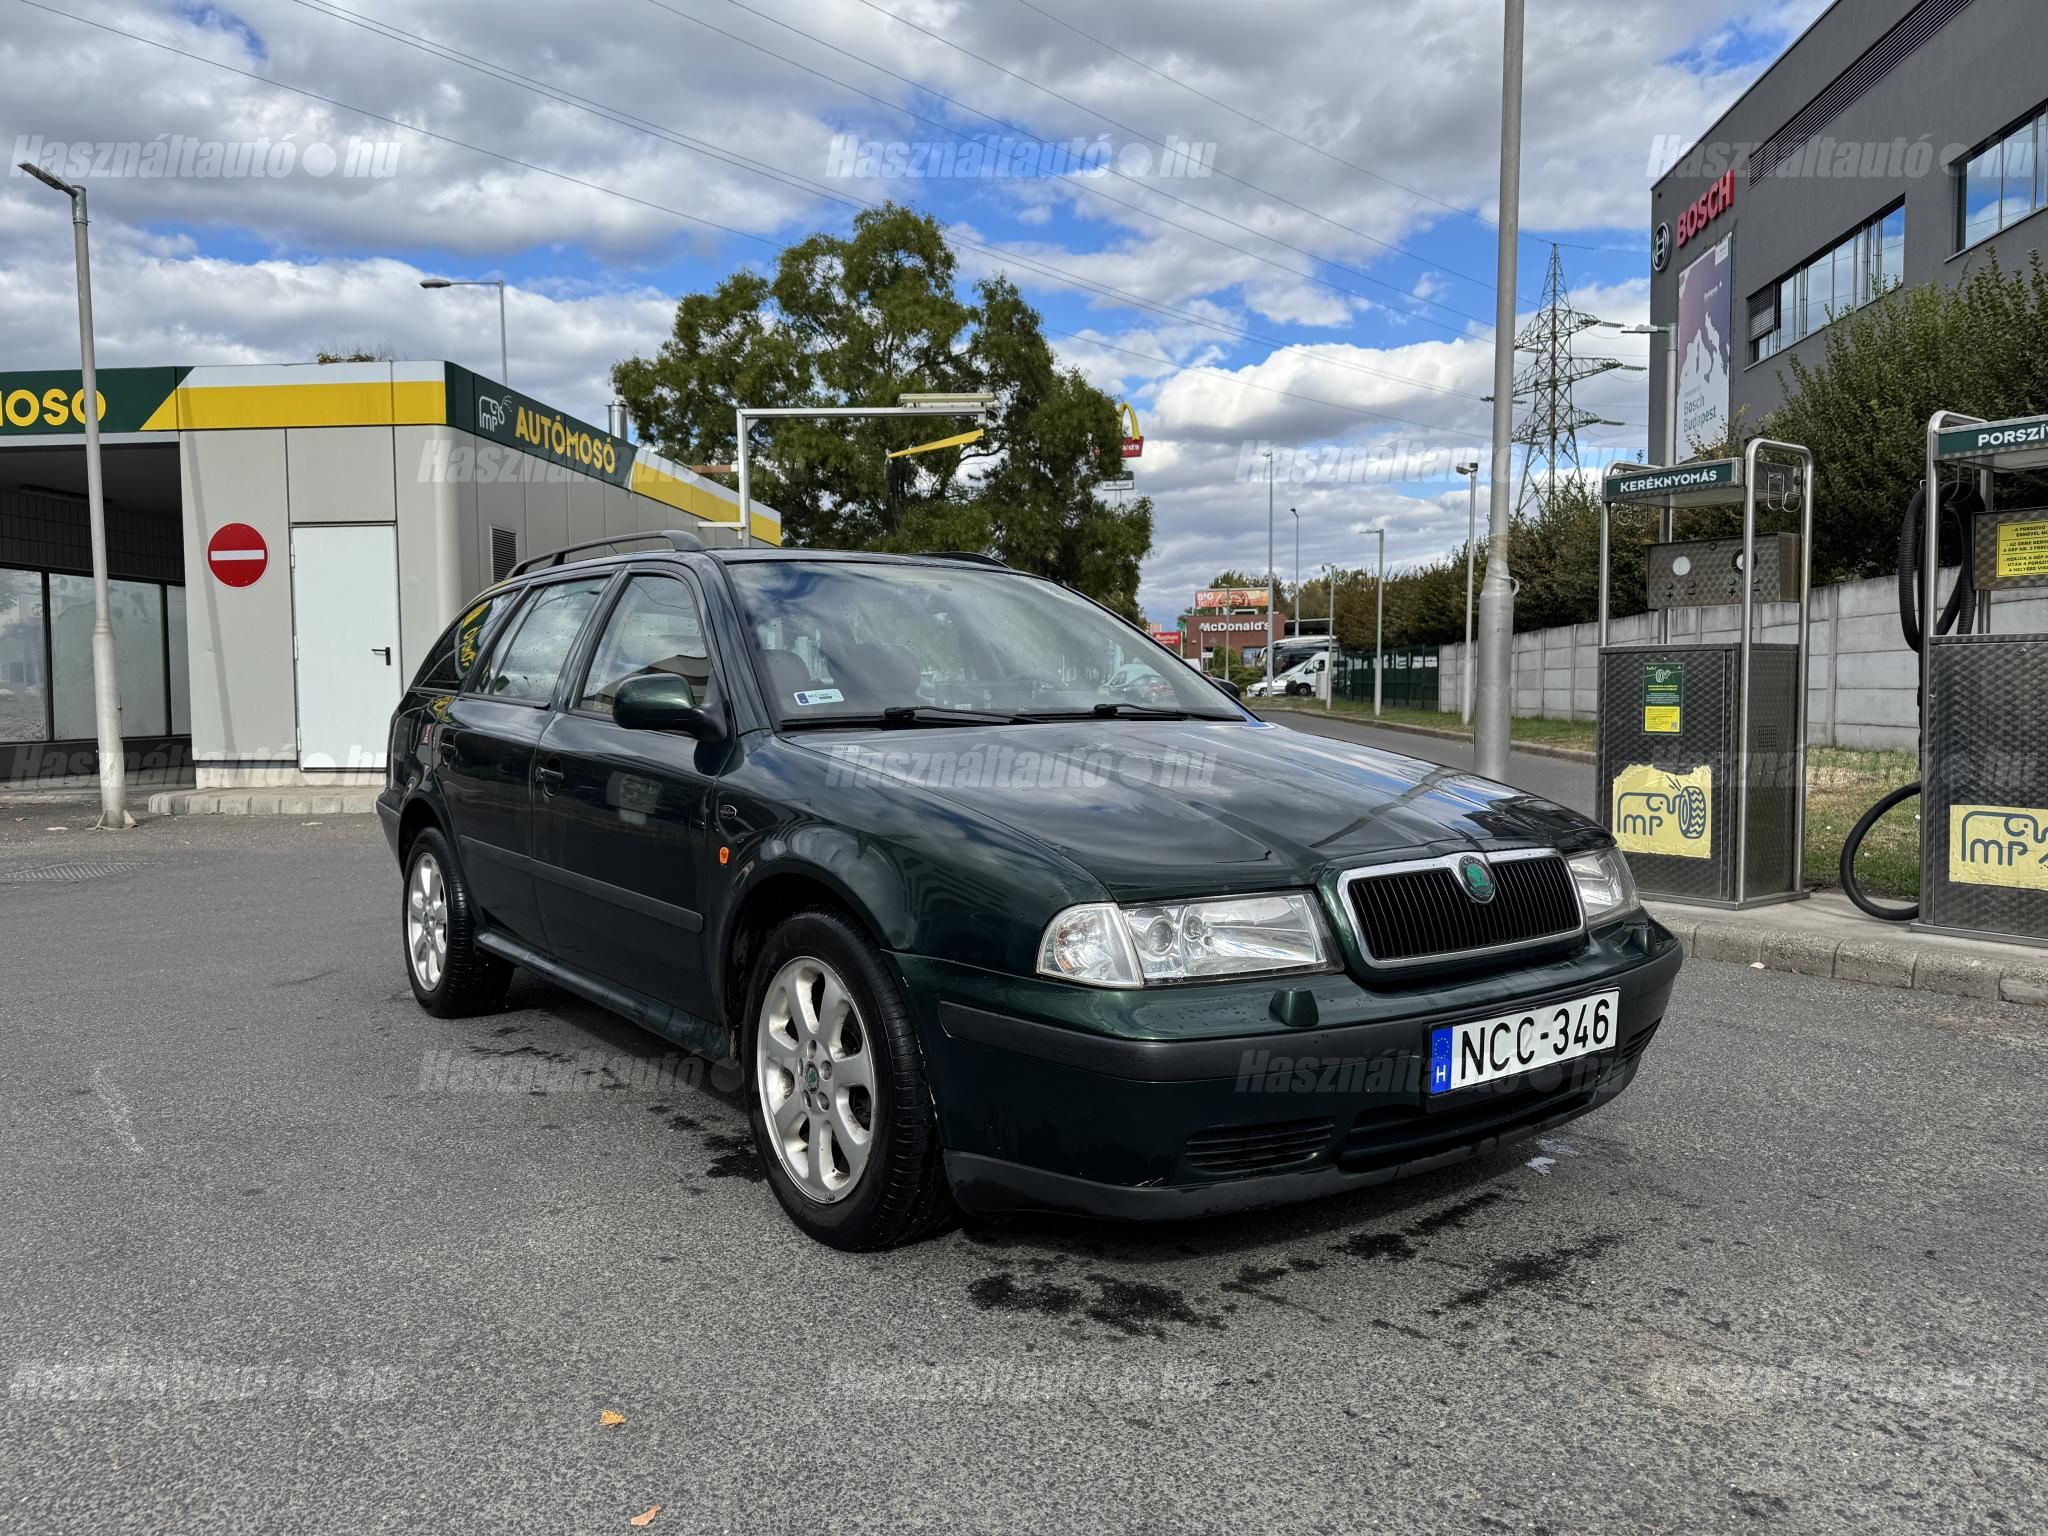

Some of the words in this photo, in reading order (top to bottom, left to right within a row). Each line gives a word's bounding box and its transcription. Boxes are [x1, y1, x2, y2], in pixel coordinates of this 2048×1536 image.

[1676, 168, 1735, 248] BOSCH
[1684, 391, 1705, 416] Bosch
[1683, 404, 1717, 432] Budapest
[515, 406, 616, 474] AUTÓMOSÓ
[1619, 468, 1718, 493] KERÉKNYOMÁS
[1200, 621, 1269, 632] McDonald's
[1436, 1064, 1447, 1084] H
[1461, 998, 1610, 1080] NCC-346
